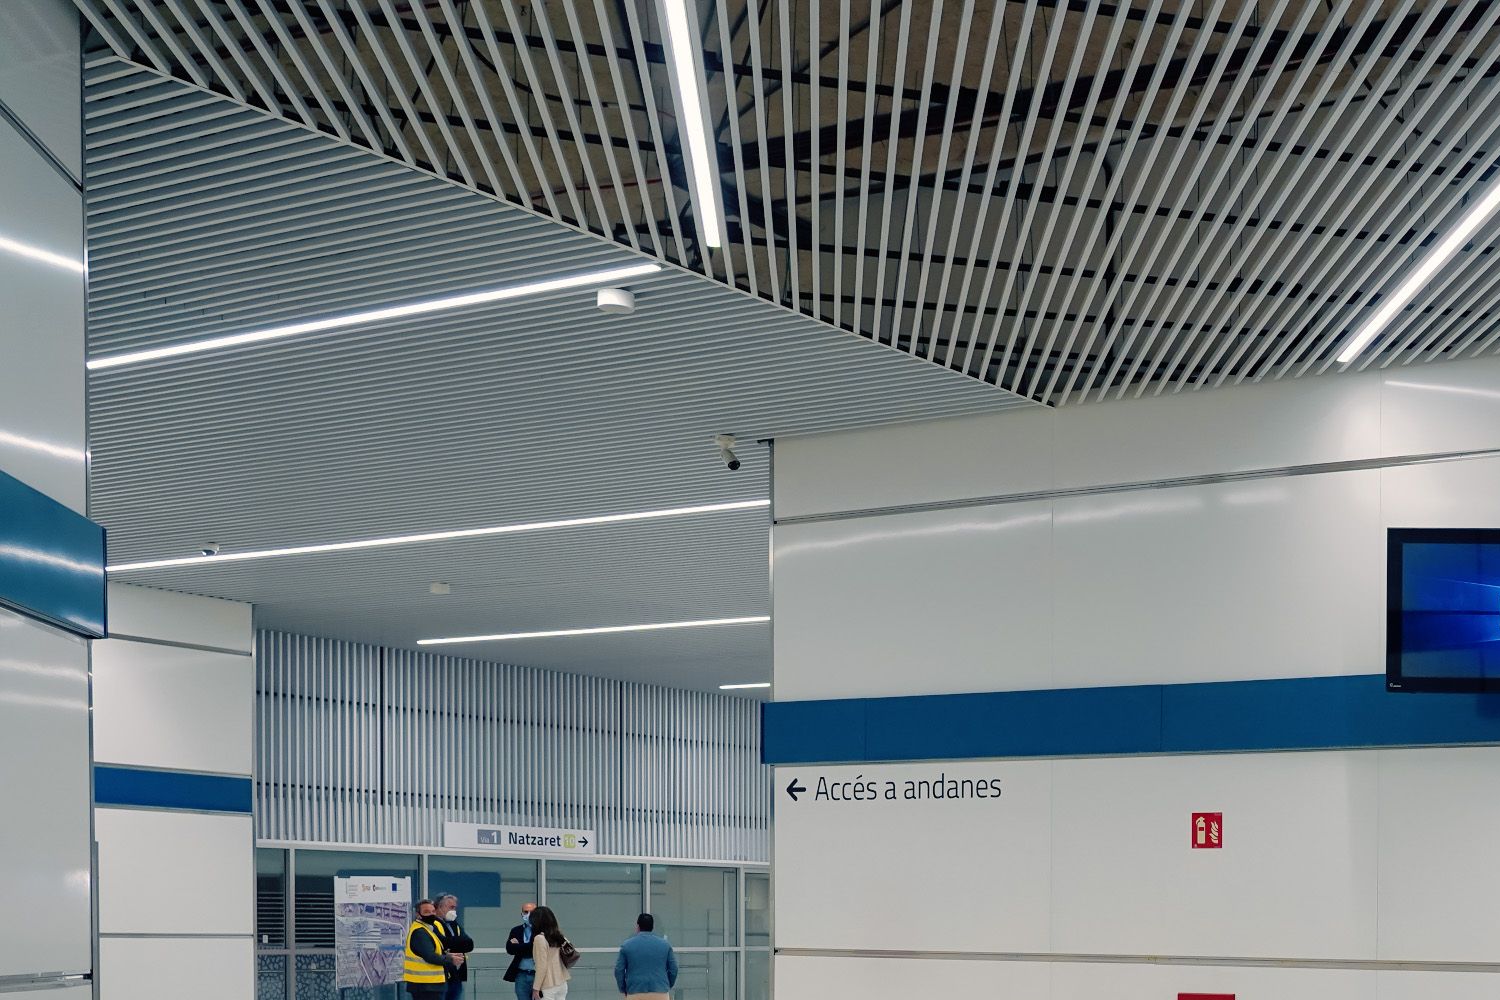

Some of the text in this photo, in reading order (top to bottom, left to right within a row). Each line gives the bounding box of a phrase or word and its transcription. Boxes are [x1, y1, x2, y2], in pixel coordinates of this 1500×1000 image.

[815, 773, 1001, 800] Accés a andanes
[491, 831, 498, 843] 1
[508, 832, 561, 847] Natzaret
